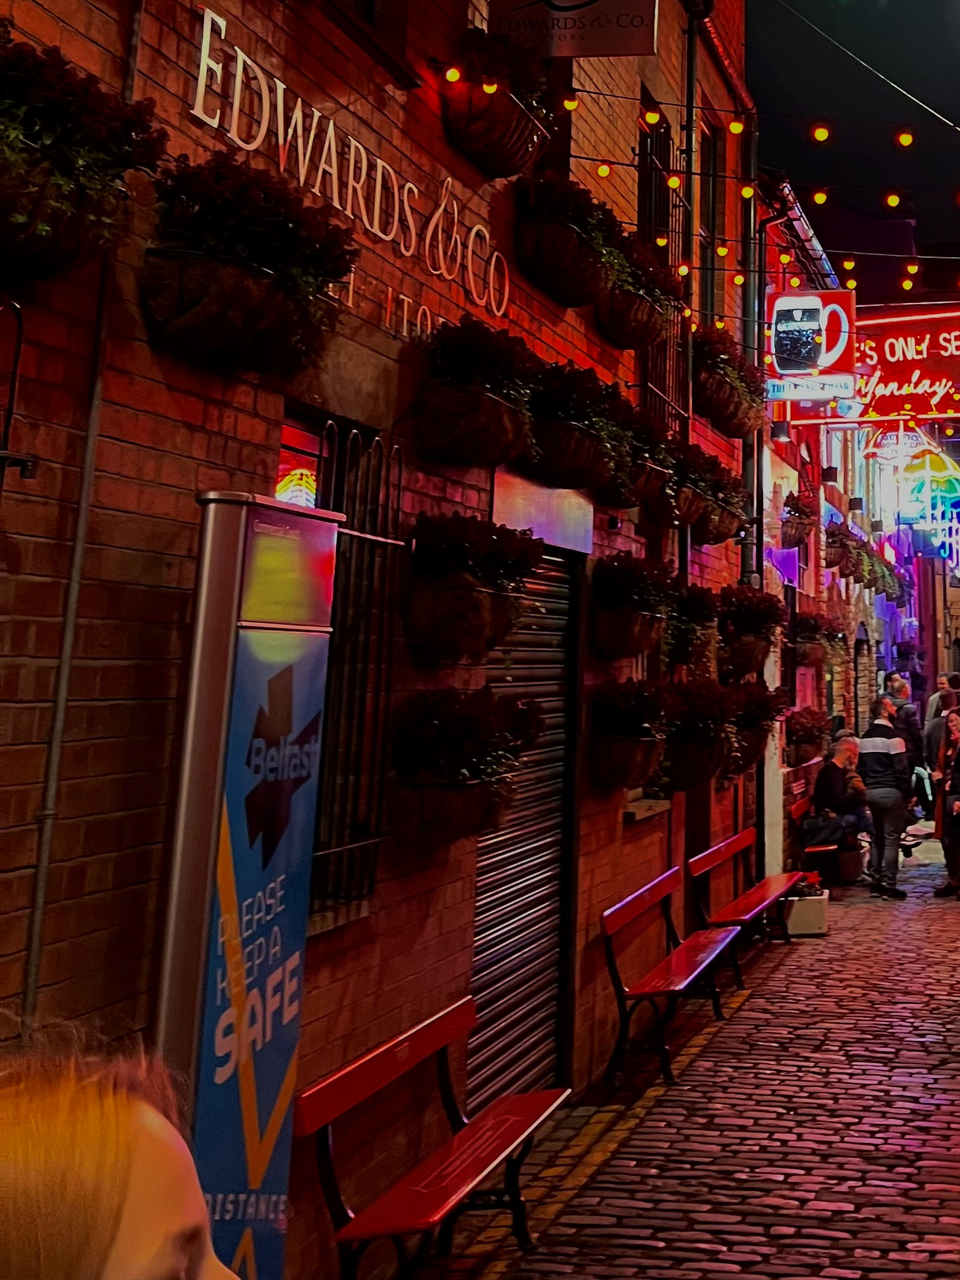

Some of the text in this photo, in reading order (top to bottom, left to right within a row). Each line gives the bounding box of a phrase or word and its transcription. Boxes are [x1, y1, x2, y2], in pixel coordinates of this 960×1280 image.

[497, 16, 586, 31] EDWARDS
[190, 4, 419, 257] EDWARDS
[884, 333, 931, 362] ONLY
[251, 731, 319, 782] Belfast
[269, 925, 282, 965] A
[213, 950, 301, 1086] SAFE
